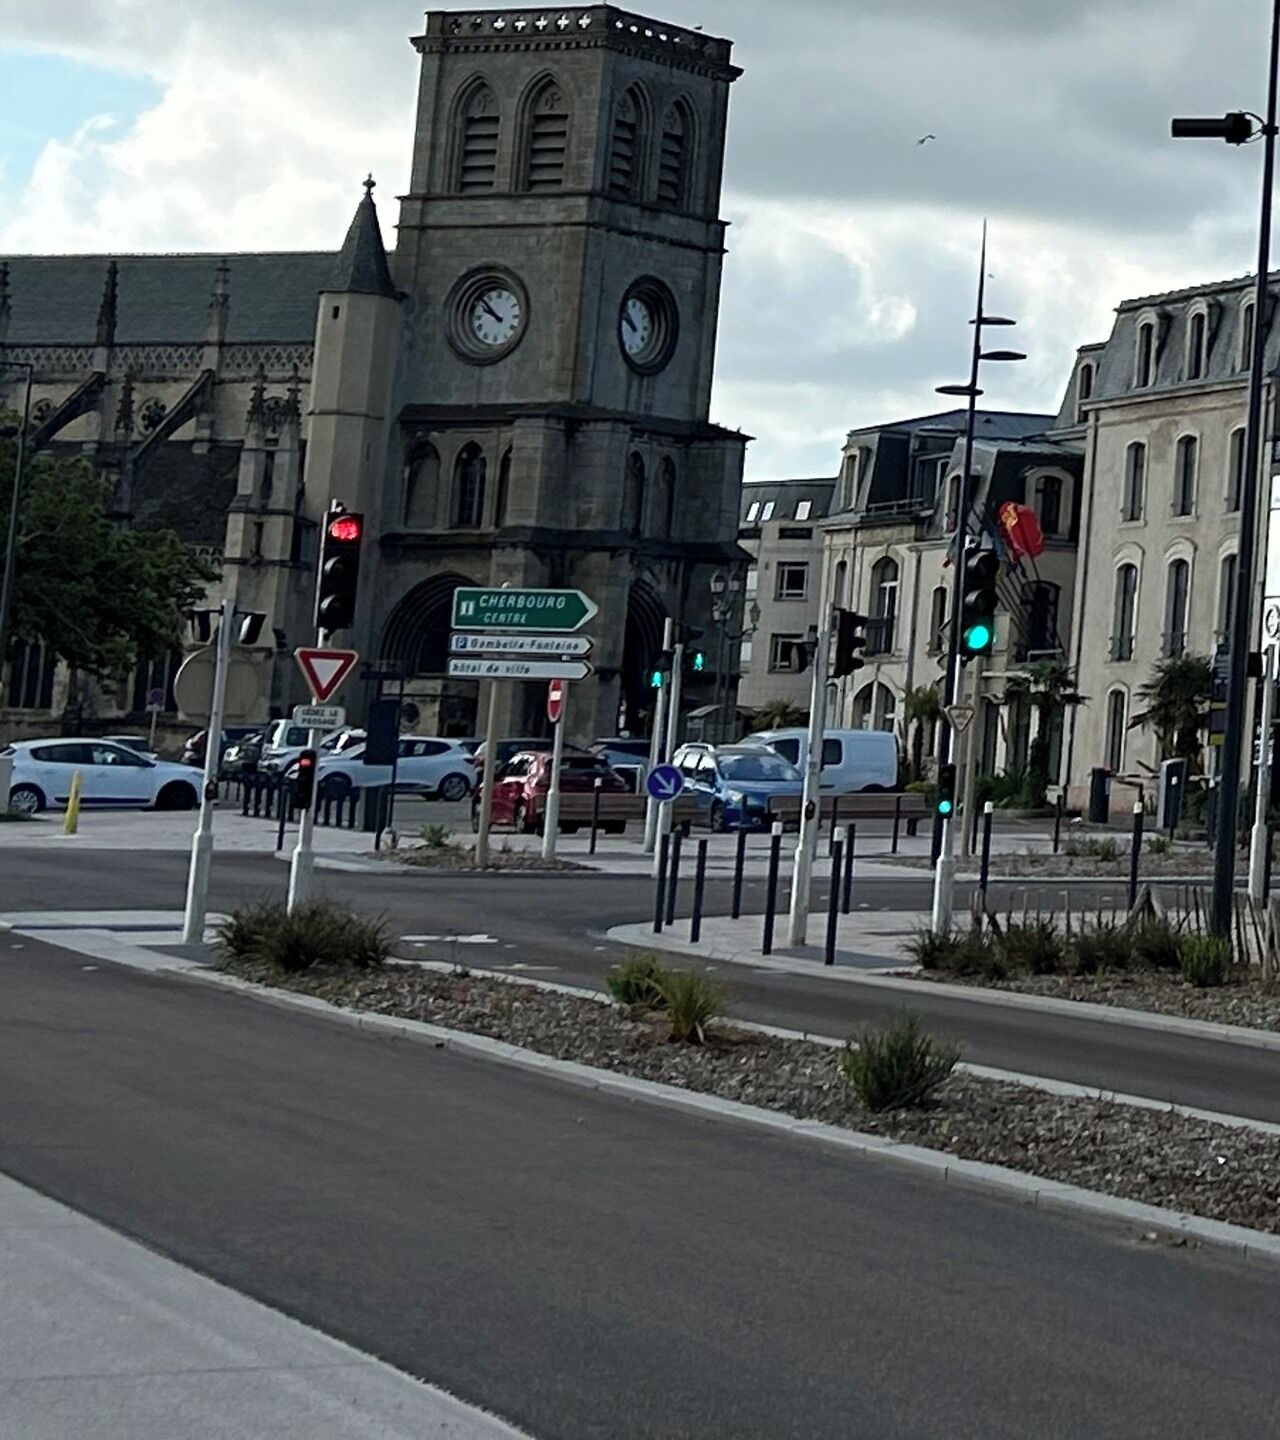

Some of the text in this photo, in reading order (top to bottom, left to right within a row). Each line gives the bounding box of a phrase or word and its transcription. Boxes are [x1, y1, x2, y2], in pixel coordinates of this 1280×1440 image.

[479, 594, 567, 609] CHERBOURG
[483, 613, 528, 624] CENTRE
[486, 663, 499, 673] de
